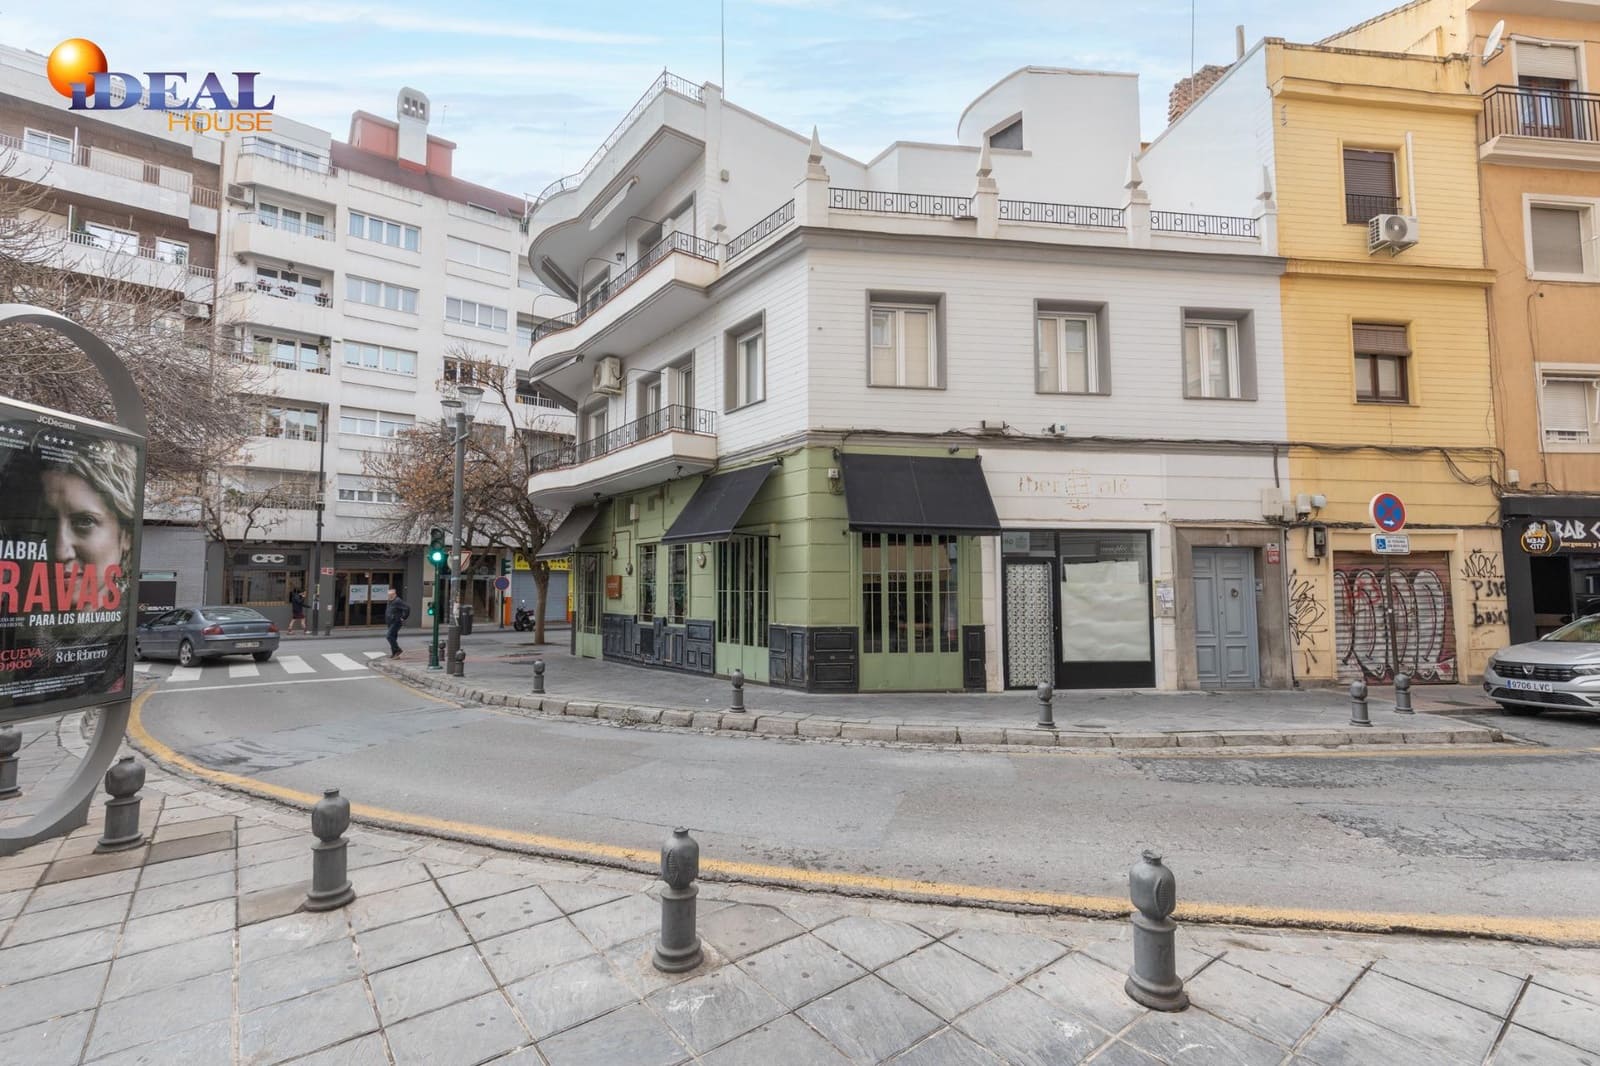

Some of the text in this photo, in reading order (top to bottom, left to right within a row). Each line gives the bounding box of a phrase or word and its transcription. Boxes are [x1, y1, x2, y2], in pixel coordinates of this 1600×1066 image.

[37, 416, 77, 431] JCDecaux
[29, 614, 55, 626] PARA
[58, 613, 75, 625] LOS
[77, 611, 121, 624] MALVADOS
[56, 649, 108, 663] 8 de febrero
[1512, 681, 1550, 692] 9706 LVC
